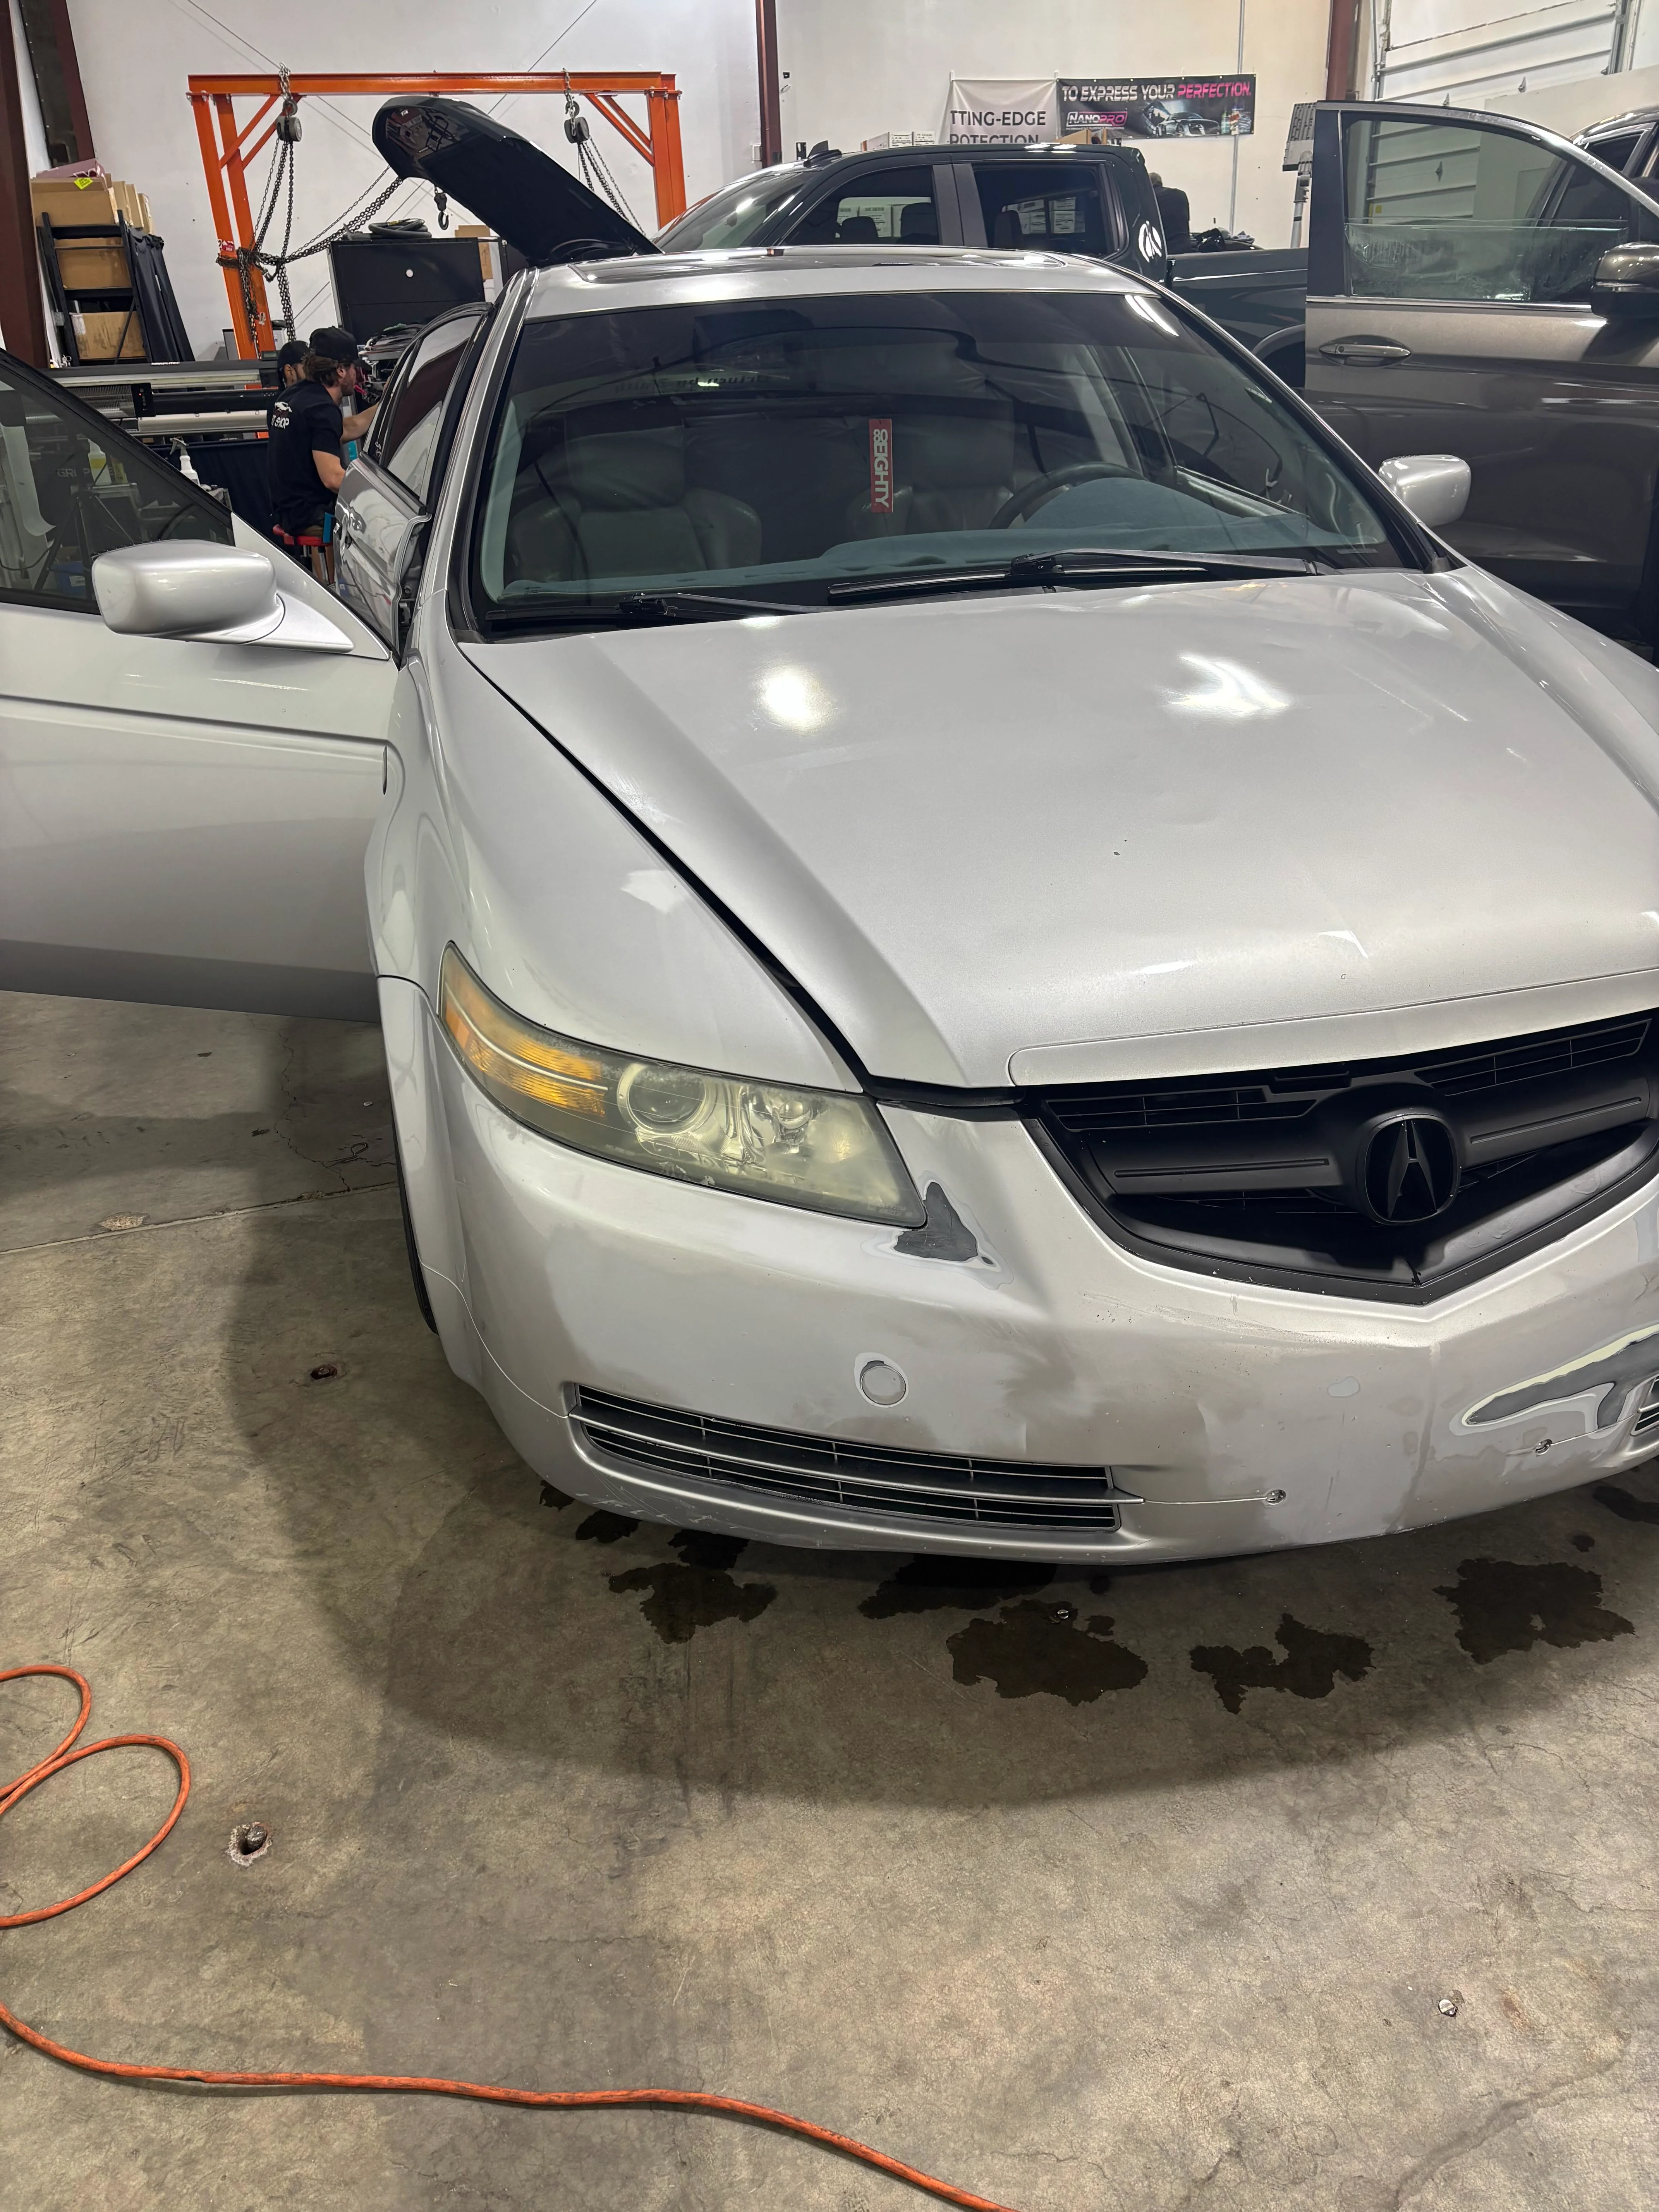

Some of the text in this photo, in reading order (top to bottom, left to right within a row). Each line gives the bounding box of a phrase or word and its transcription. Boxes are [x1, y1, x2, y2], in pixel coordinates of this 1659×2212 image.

[1062, 86, 1078, 101] TO
[1080, 85, 1138, 101] EXPRESS
[1142, 84, 1175, 100] YOUR
